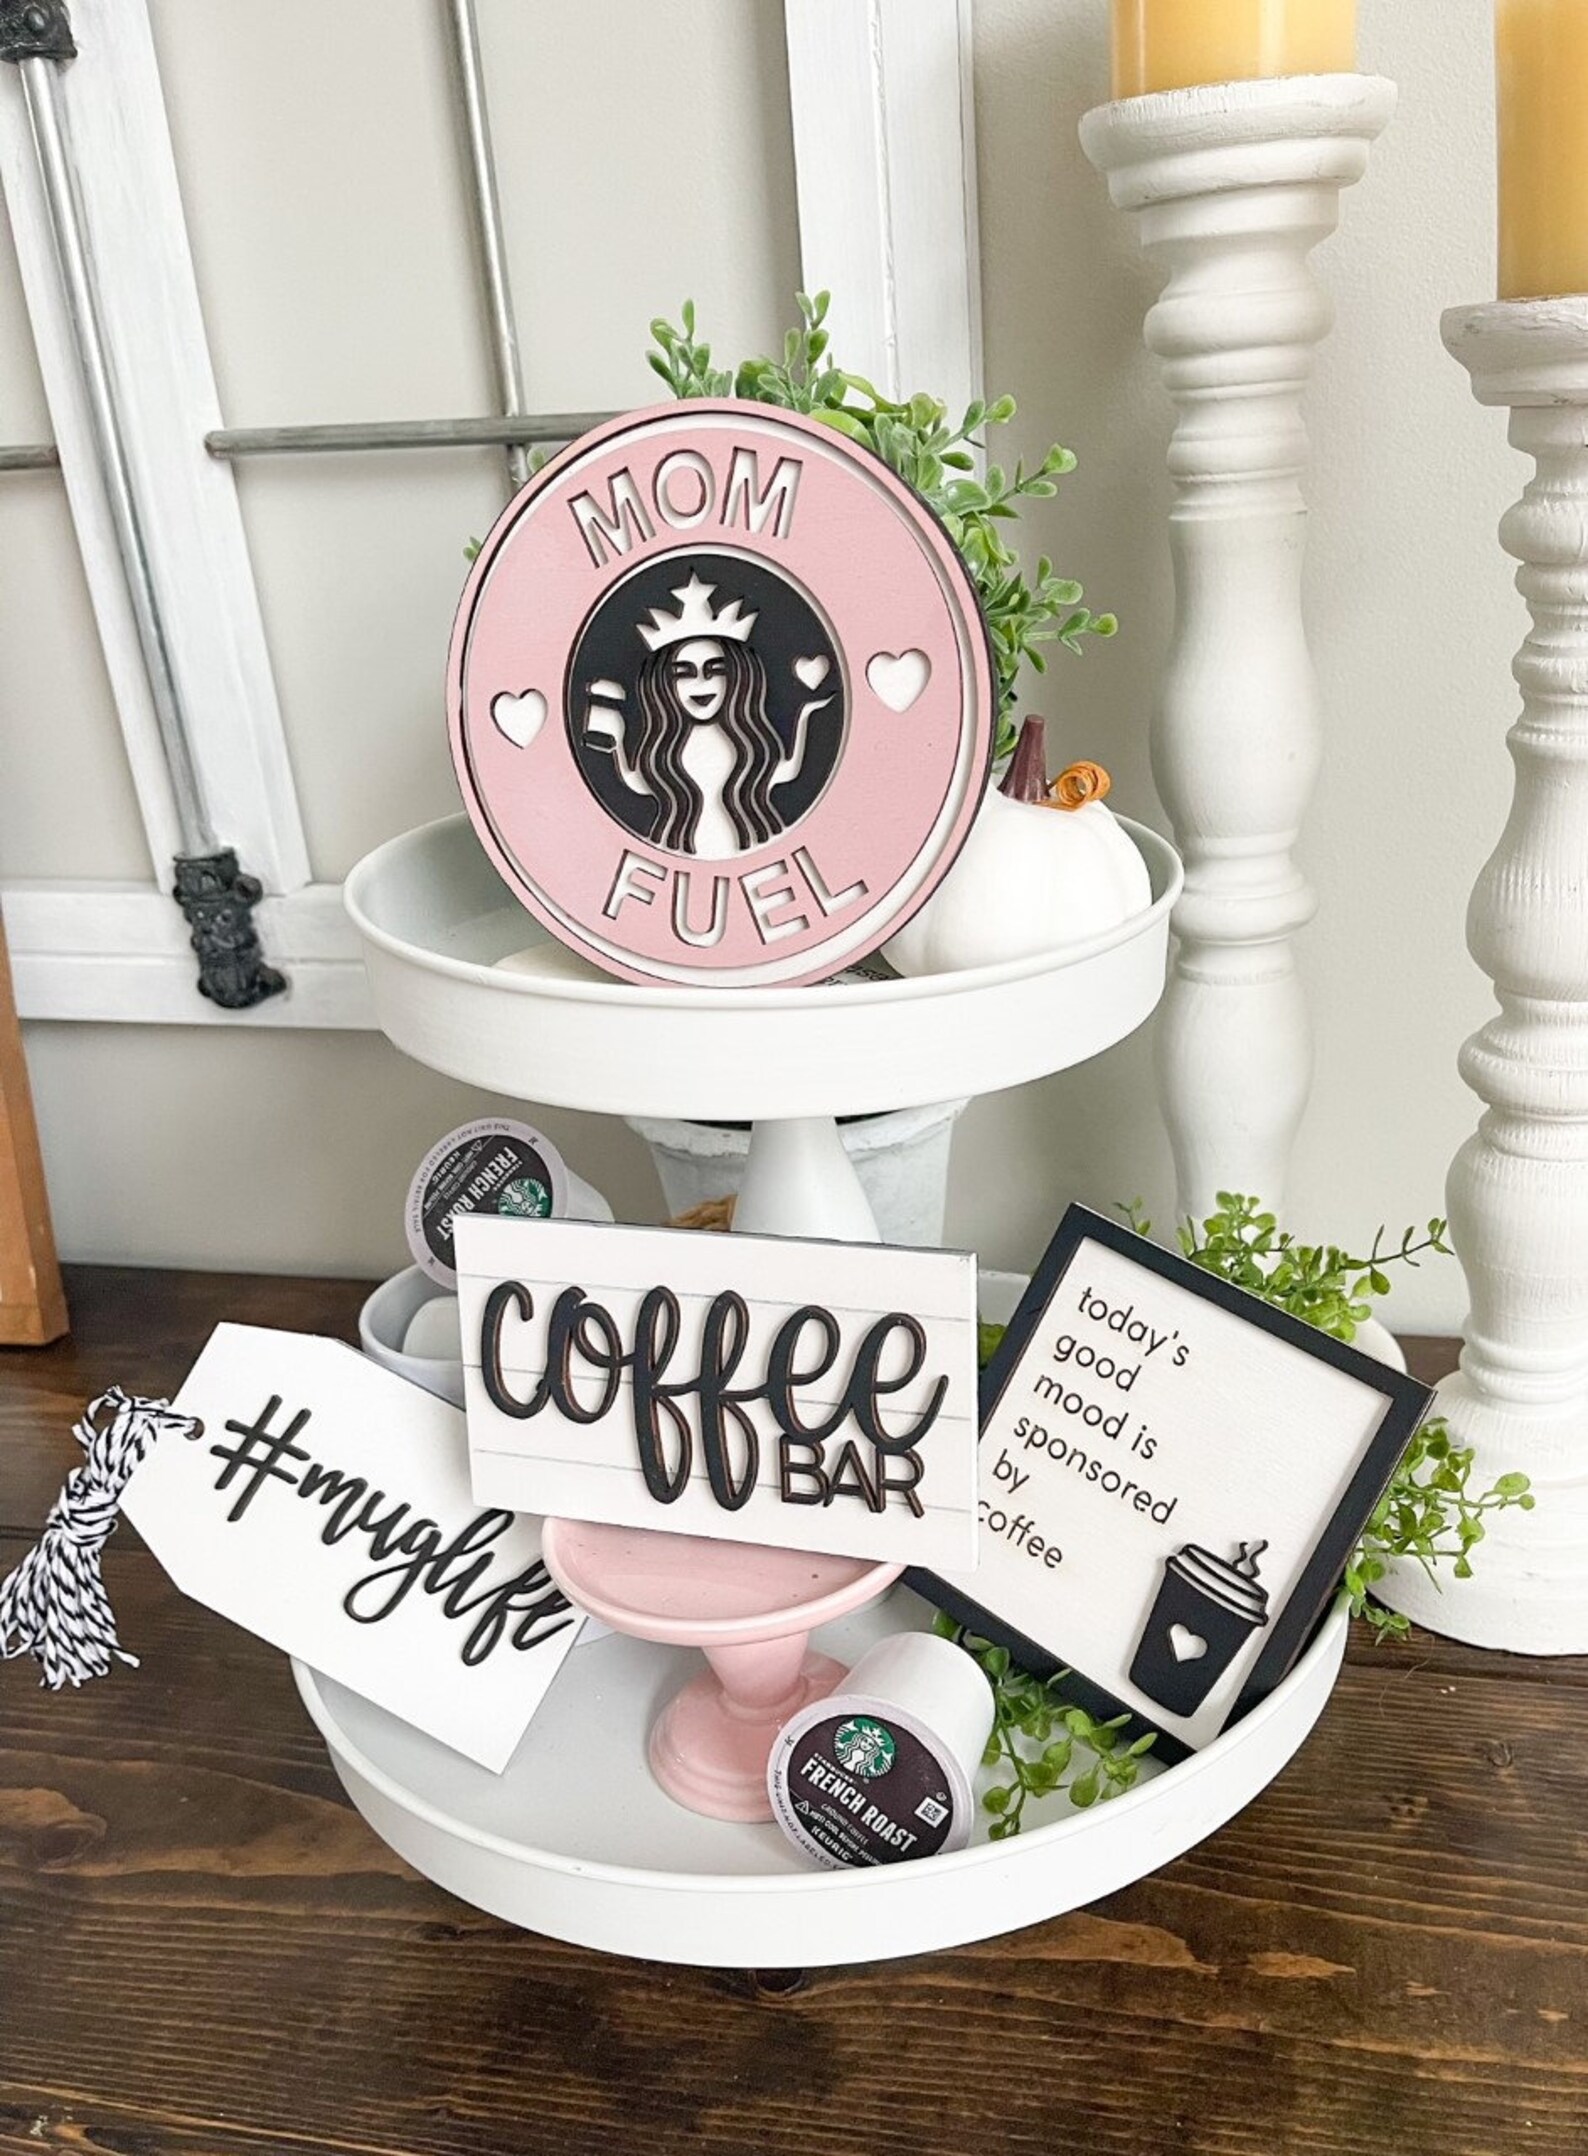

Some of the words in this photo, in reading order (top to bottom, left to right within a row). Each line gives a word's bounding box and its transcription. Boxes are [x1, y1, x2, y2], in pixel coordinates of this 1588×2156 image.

[566, 446, 803, 569] MOM
[601, 845, 869, 948] FUEL
[468, 1146, 519, 1201] FRENCH
[1053, 1335, 1142, 1392] good
[1077, 1286, 1190, 1367] today's
[481, 1280, 949, 1511] coffee
[1033, 1374, 1129, 1440] mood
[1131, 1424, 1158, 1460] is
[779, 1433, 925, 1518] BAR
[992, 1448, 1031, 1494] by
[1013, 1416, 1178, 1525] sponsored
[209, 1394, 575, 1667] #muglife
[800, 1758, 867, 1814] FRENCH
[860, 1805, 918, 1852] ROAST
[811, 1825, 853, 1860] KEURIG
